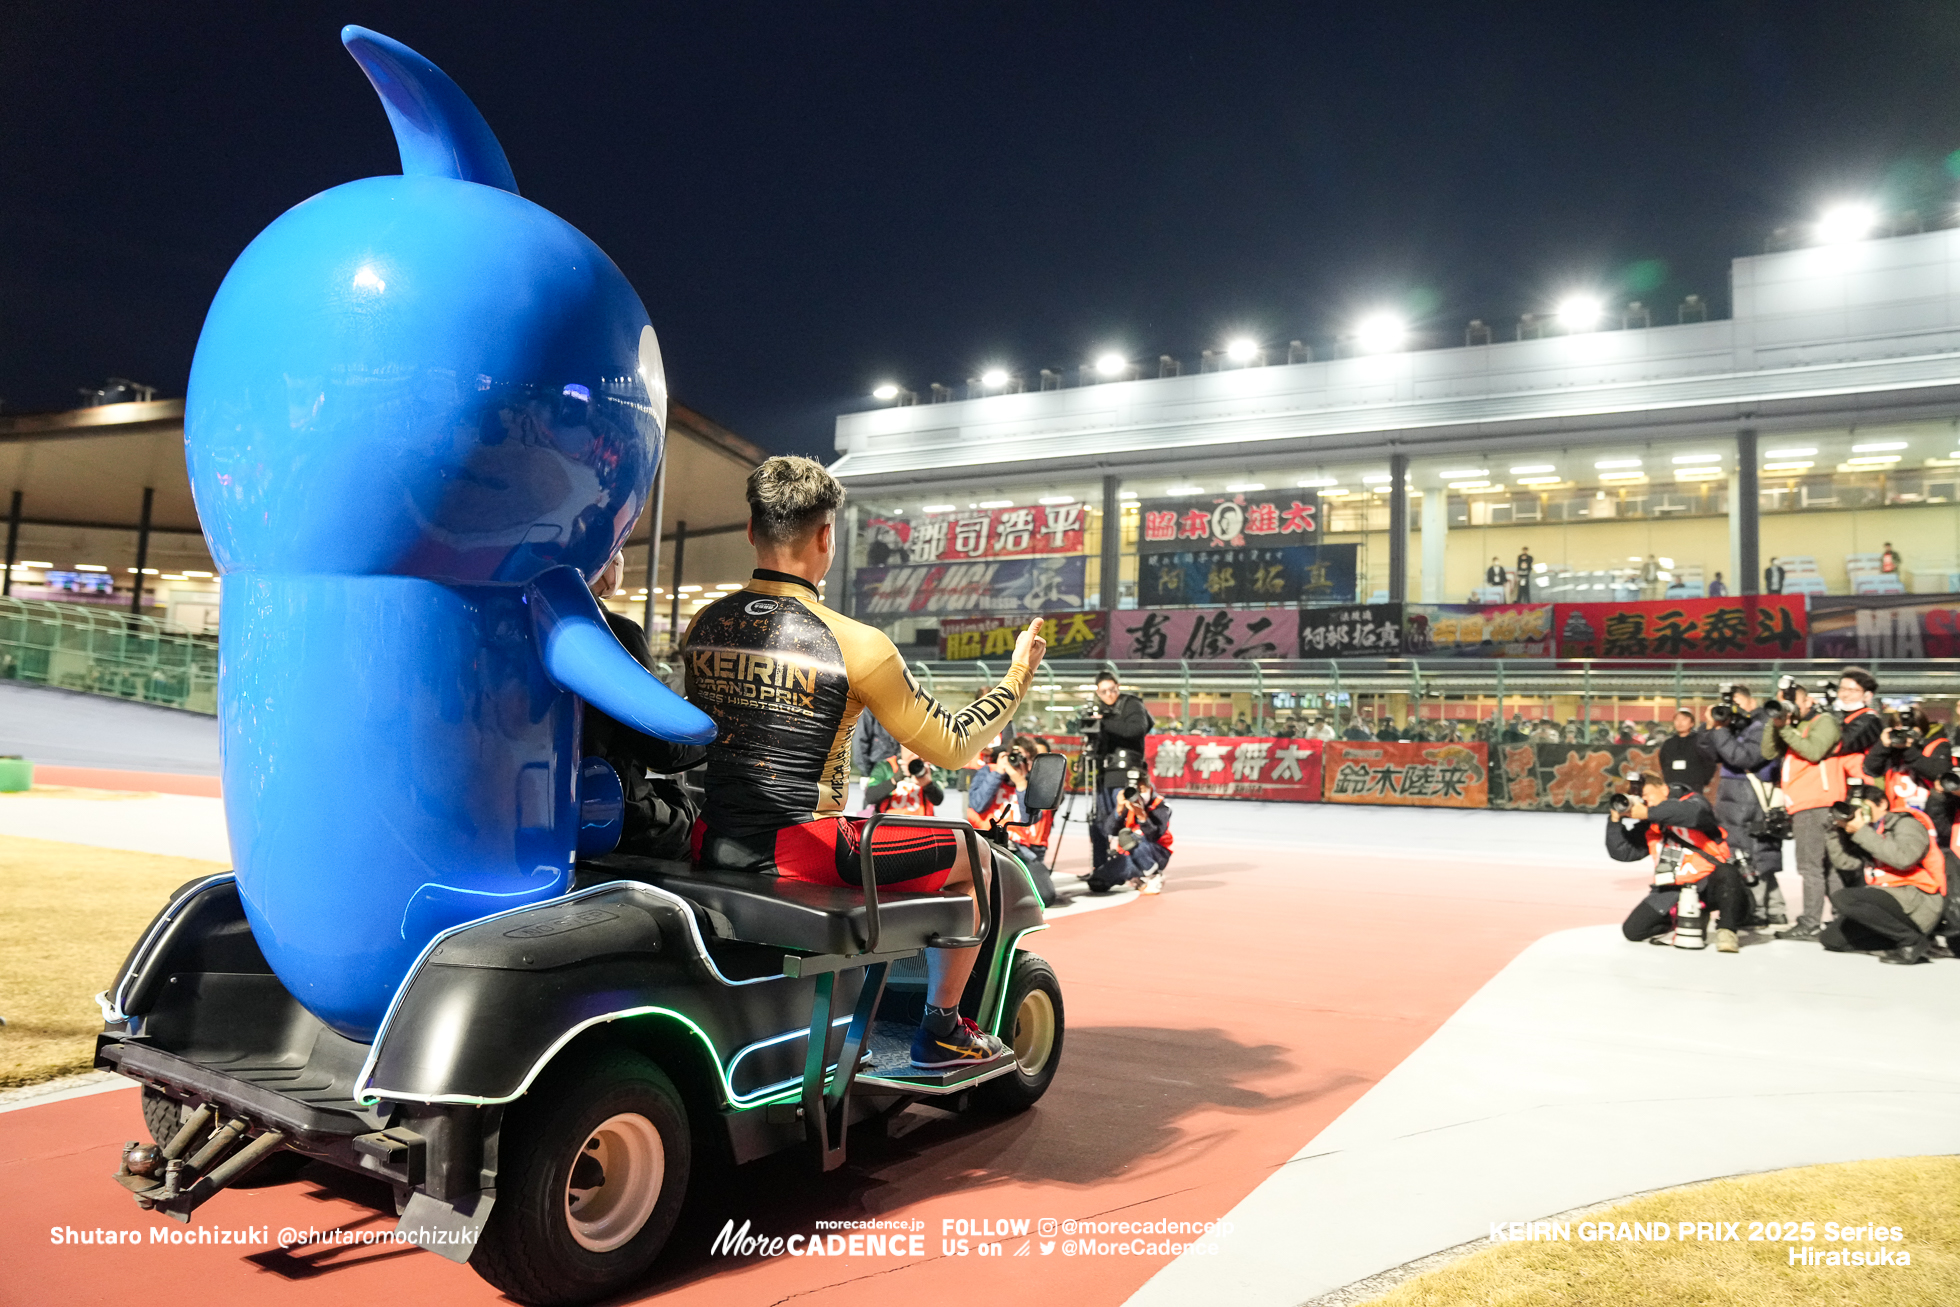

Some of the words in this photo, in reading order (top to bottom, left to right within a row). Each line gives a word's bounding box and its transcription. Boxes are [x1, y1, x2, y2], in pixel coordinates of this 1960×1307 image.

[911, 503, 1083, 562] 郡司浩平
[1303, 621, 1400, 651] 阿部拓真
[1603, 606, 1803, 657] 嘉永泰斗
[693, 650, 818, 694] KEIRIN
[760, 685, 815, 709] PRIX
[1332, 762, 1469, 799] 鈴木陸来
